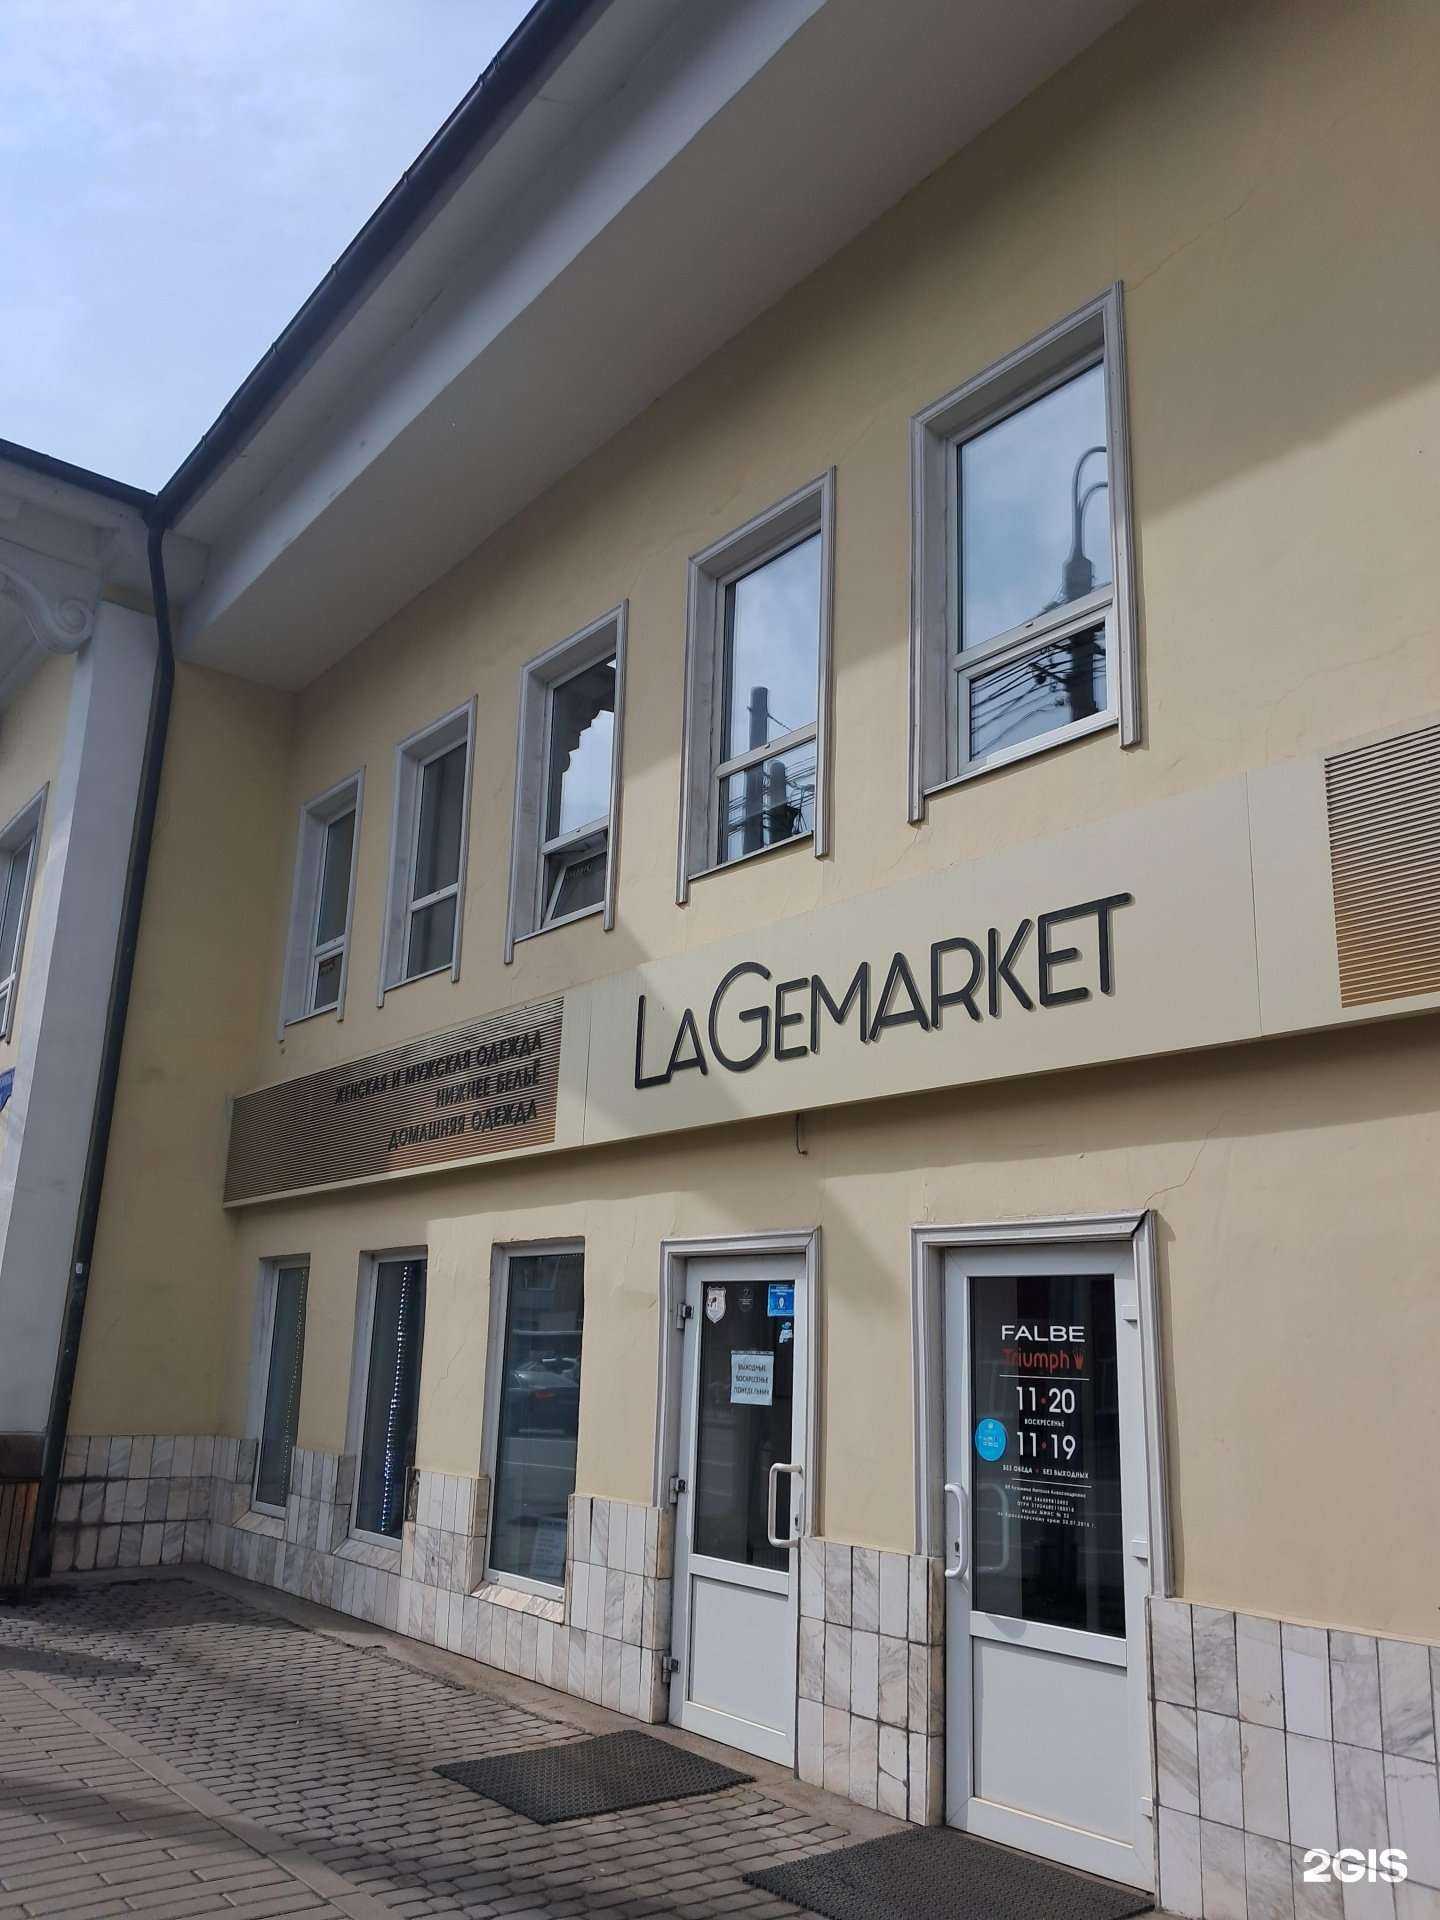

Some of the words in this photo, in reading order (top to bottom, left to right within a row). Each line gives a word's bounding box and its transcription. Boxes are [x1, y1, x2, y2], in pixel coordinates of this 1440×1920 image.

[335, 1073, 387, 1104] ЖЕНСКАЯ
[392, 1069, 401, 1089] И
[404, 1050, 471, 1085] МУЖСКАЯ
[476, 1030, 542, 1067] ОДЕЖДА
[435, 1075, 490, 1108] НИЖНЕЕ
[496, 1058, 541, 1094] БЕЛЬЁ
[387, 1114, 466, 1151] ДОМАШНЯЯ
[472, 1099, 537, 1131] ОДЕЖДА
[1001, 1325, 1086, 1343] FALBE
[1001, 1348, 1070, 1374] Triumph
[1024, 1418, 1065, 1428] ВОСКРЕСЕНЬЕ
[1013, 1465, 1033, 1474] ОБЕДА
[1042, 1468, 1053, 1476] БЕЗ
[1053, 1469, 1089, 1479] ВЫХОДНЫХ
